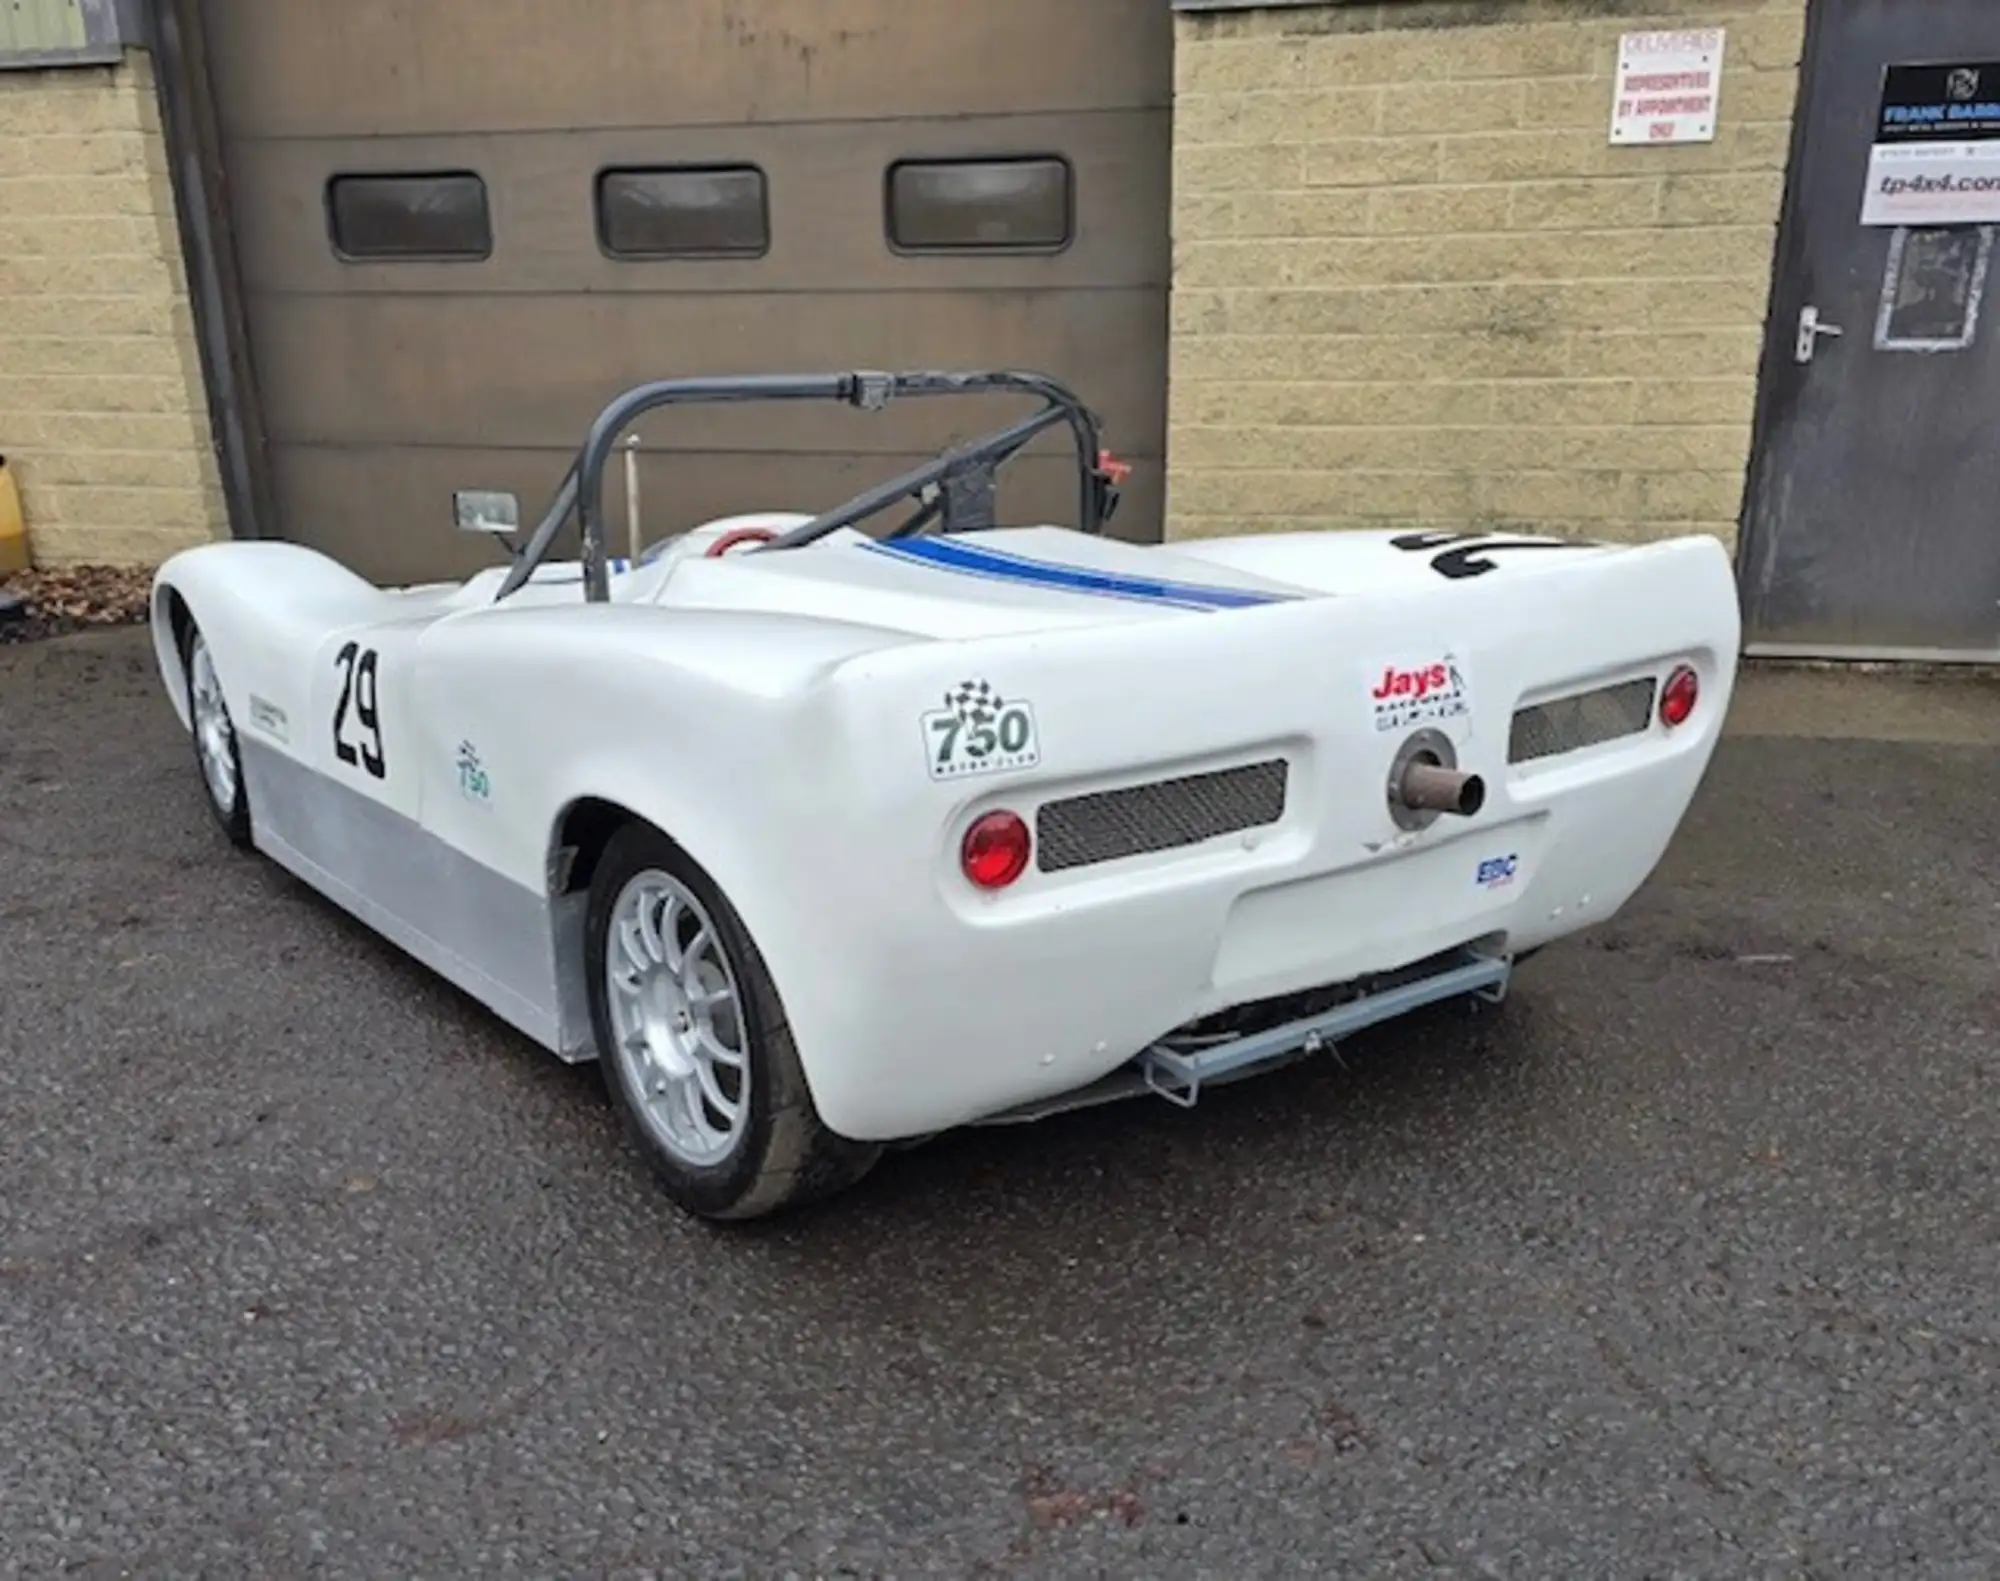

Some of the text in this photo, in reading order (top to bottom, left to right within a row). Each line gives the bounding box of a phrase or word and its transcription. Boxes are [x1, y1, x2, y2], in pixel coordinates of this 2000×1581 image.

[1884, 105, 1945, 123] FRANK
[1373, 664, 1446, 699] Jays
[334, 641, 385, 779] 29
[932, 709, 1030, 763] 750
